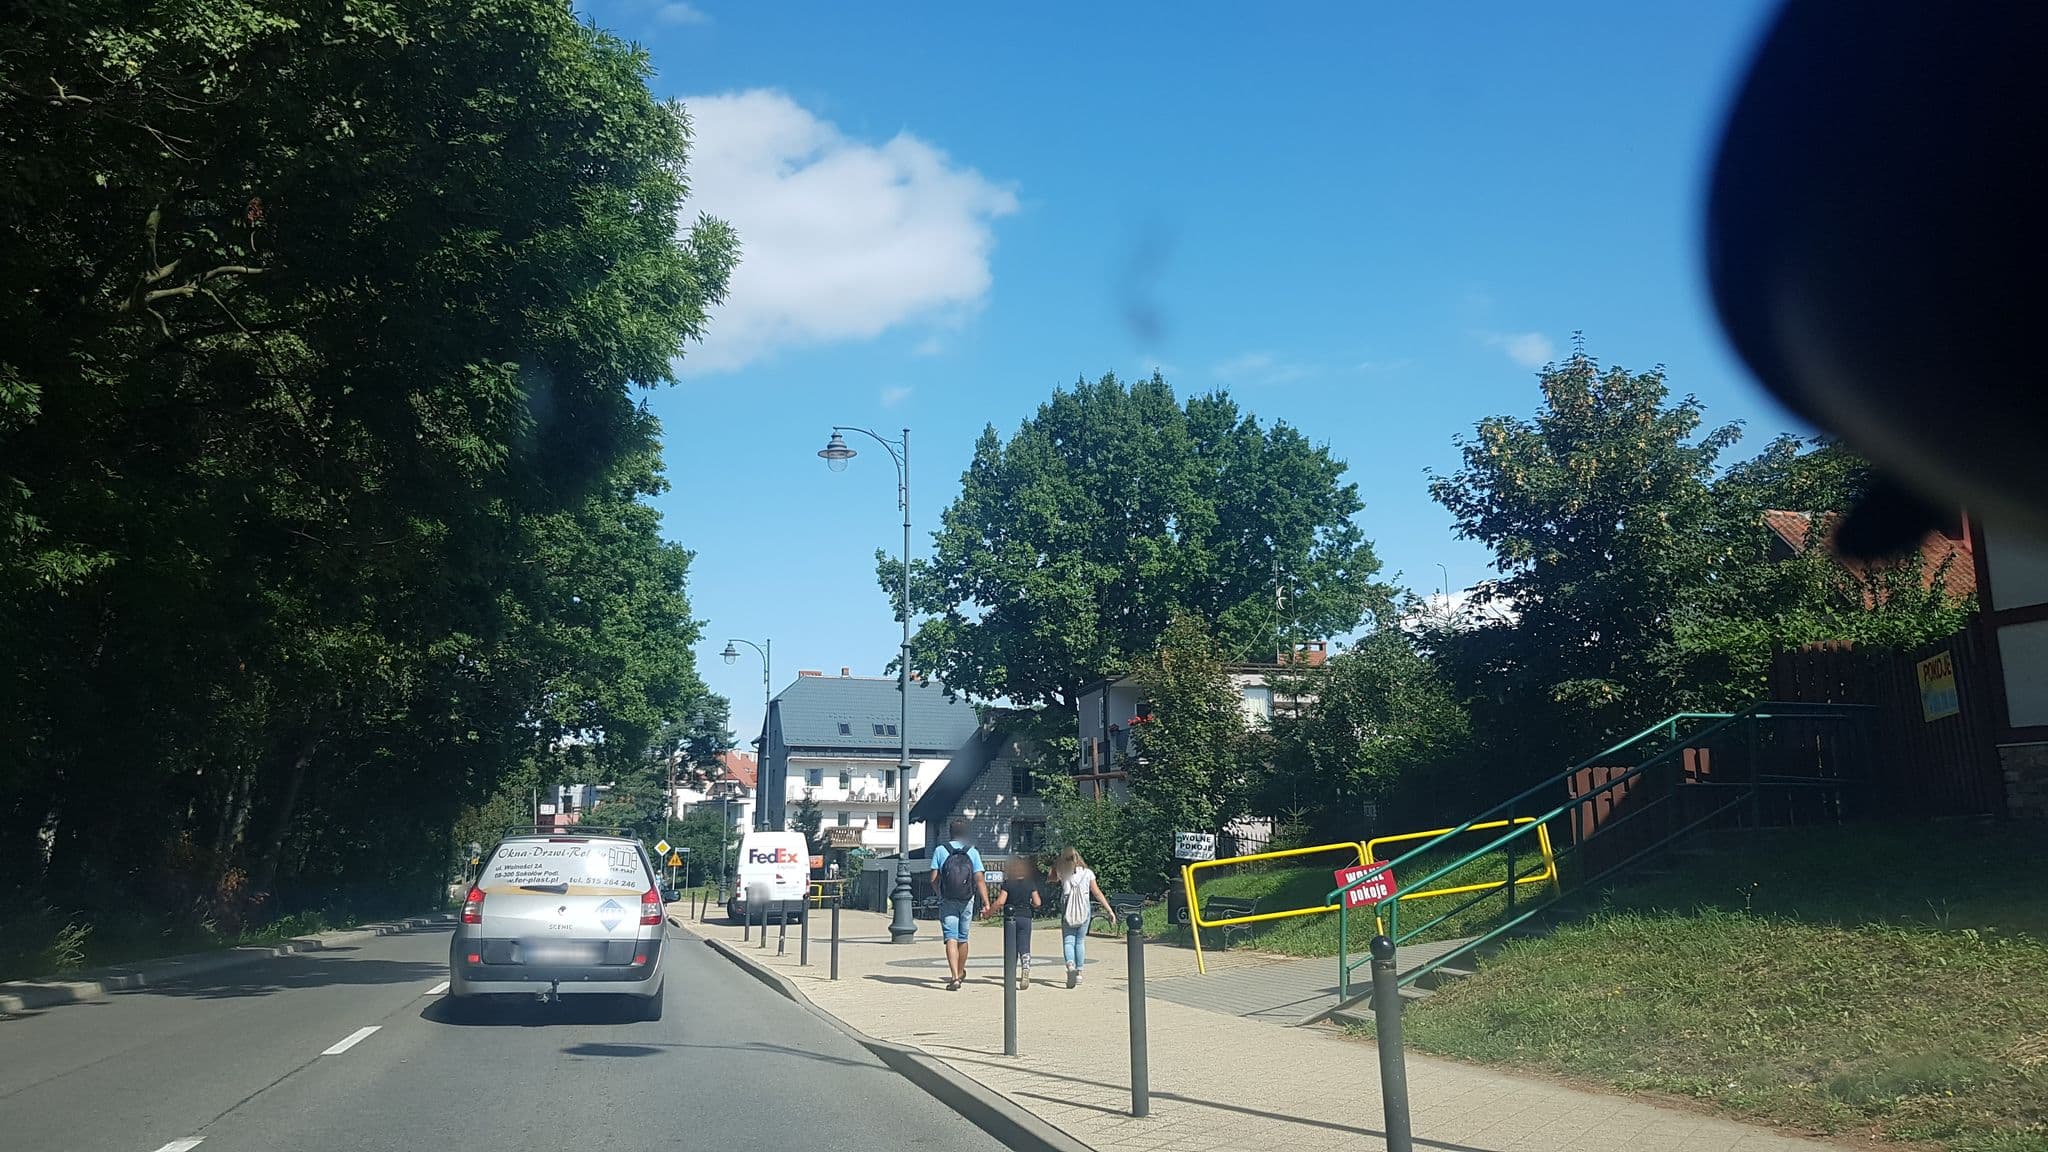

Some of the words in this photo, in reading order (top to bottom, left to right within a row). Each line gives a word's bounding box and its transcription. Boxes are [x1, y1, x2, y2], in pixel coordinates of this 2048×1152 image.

[1183, 834, 1212, 842] WOLNE
[1180, 843, 1213, 851] POKOJE
[498, 846, 607, 859] Okna-Drzwi-Rol
[749, 848, 798, 864] FedEx
[621, 880, 636, 888] 246
[1350, 883, 1388, 904] pokoje
